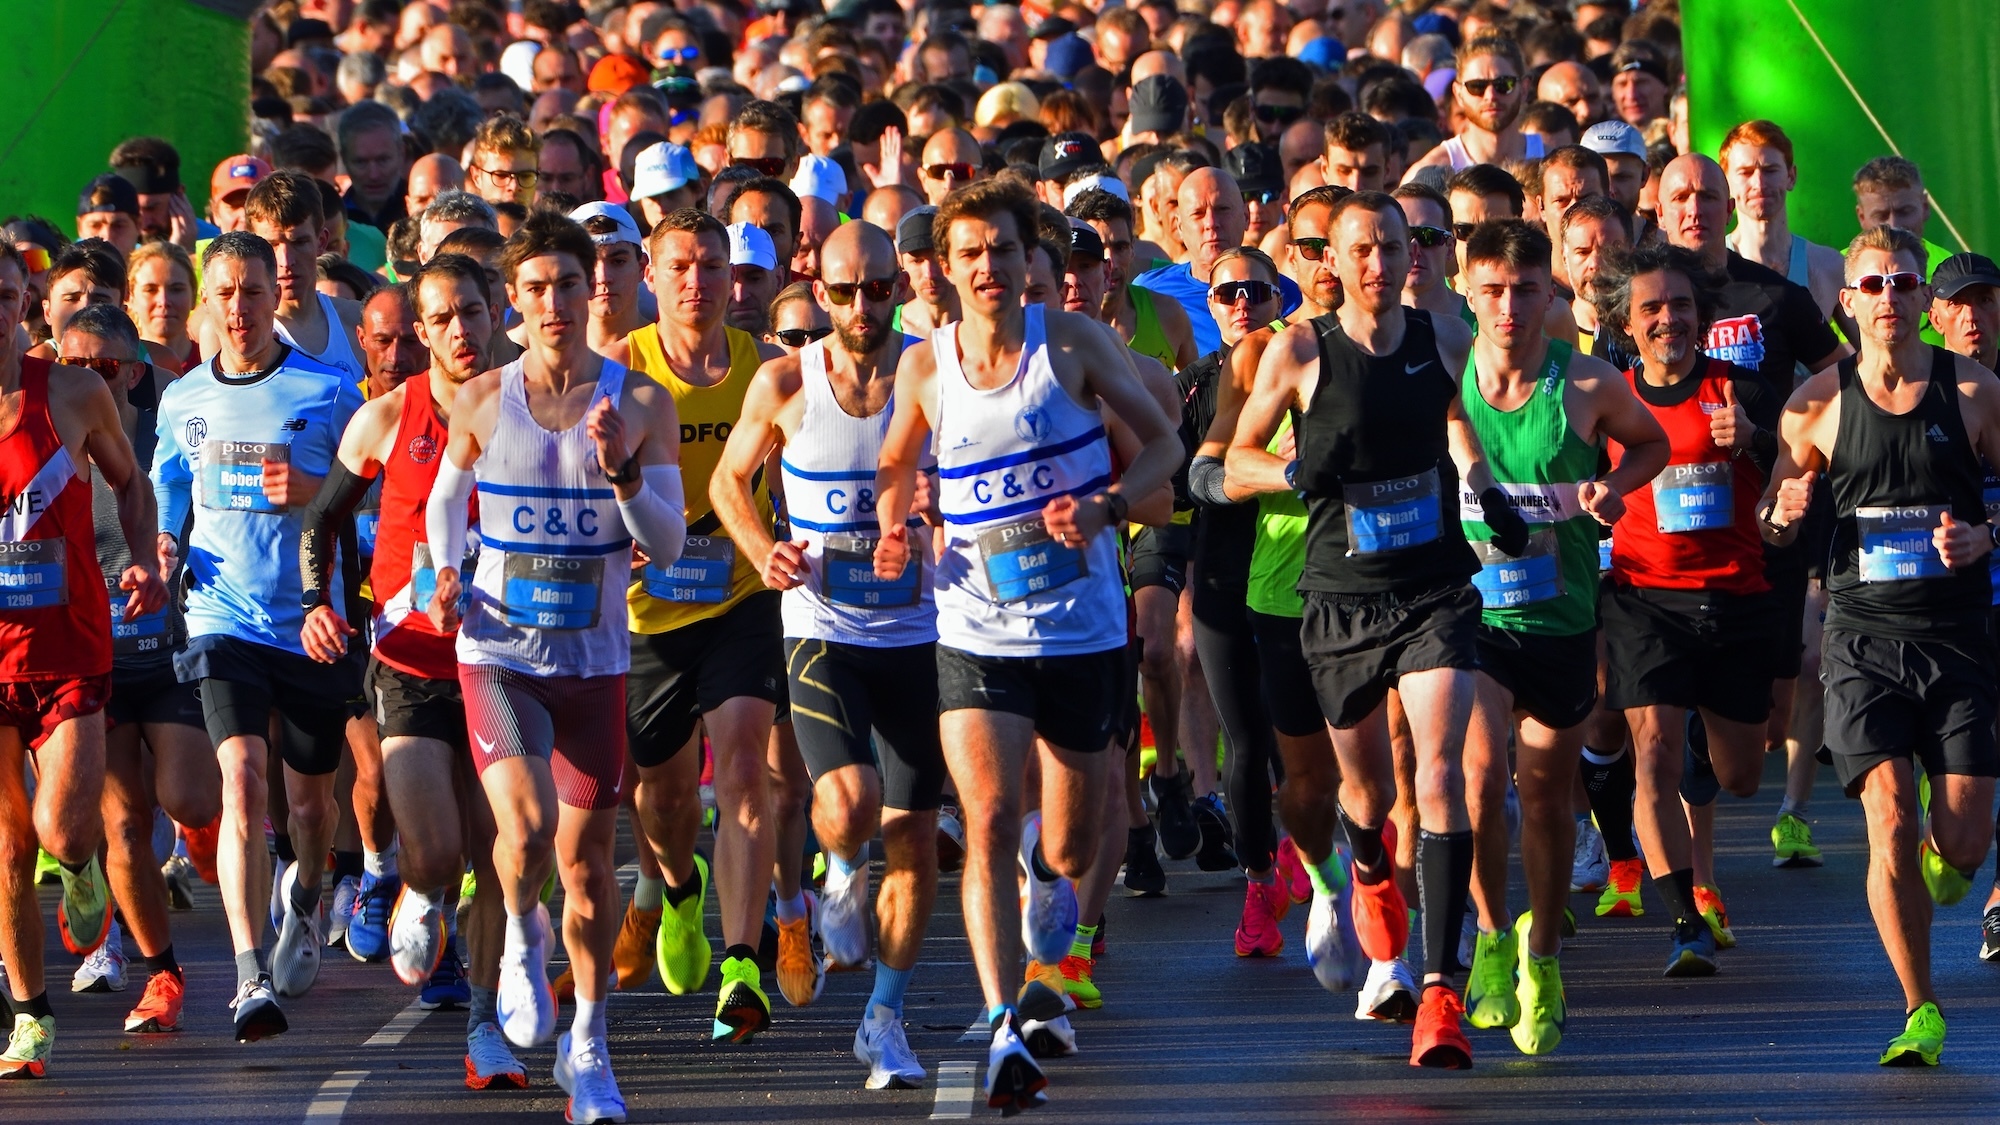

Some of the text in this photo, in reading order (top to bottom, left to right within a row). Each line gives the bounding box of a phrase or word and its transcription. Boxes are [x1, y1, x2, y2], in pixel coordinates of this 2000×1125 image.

[1542, 360, 1560, 395] soar
[222, 442, 266, 455] pico
[1675, 464, 1718, 479] pico
[974, 465, 1054, 504] C & C
[1373, 479, 1419, 497] pico
[231, 495, 252, 508] 359
[826, 488, 876, 515] C &
[1508, 495, 1549, 507] RUNNERS
[1680, 492, 1715, 507] David
[513, 505, 598, 536] C & C
[1377, 507, 1420, 527] Stuart
[1690, 514, 1706, 526] 772
[1882, 507, 1929, 523] pico
[686, 537, 710, 547] co
[1391, 532, 1410, 547] 787
[1883, 539, 1928, 554] Daniel
[532, 557, 580, 570] pico
[1018, 554, 1048, 571] Ben
[1896, 562, 1917, 576] 100
[665, 564, 707, 581] Danny
[1500, 569, 1527, 583] Ben
[1028, 575, 1049, 590] 697
[6, 594, 33, 607] 1299
[532, 587, 573, 604] Adam
[671, 587, 696, 600] 1381
[865, 592, 879, 604] 50
[1503, 590, 1530, 603] 1238
[537, 612, 565, 626] 1230
[118, 624, 138, 636] 326
[138, 637, 158, 650] 326
